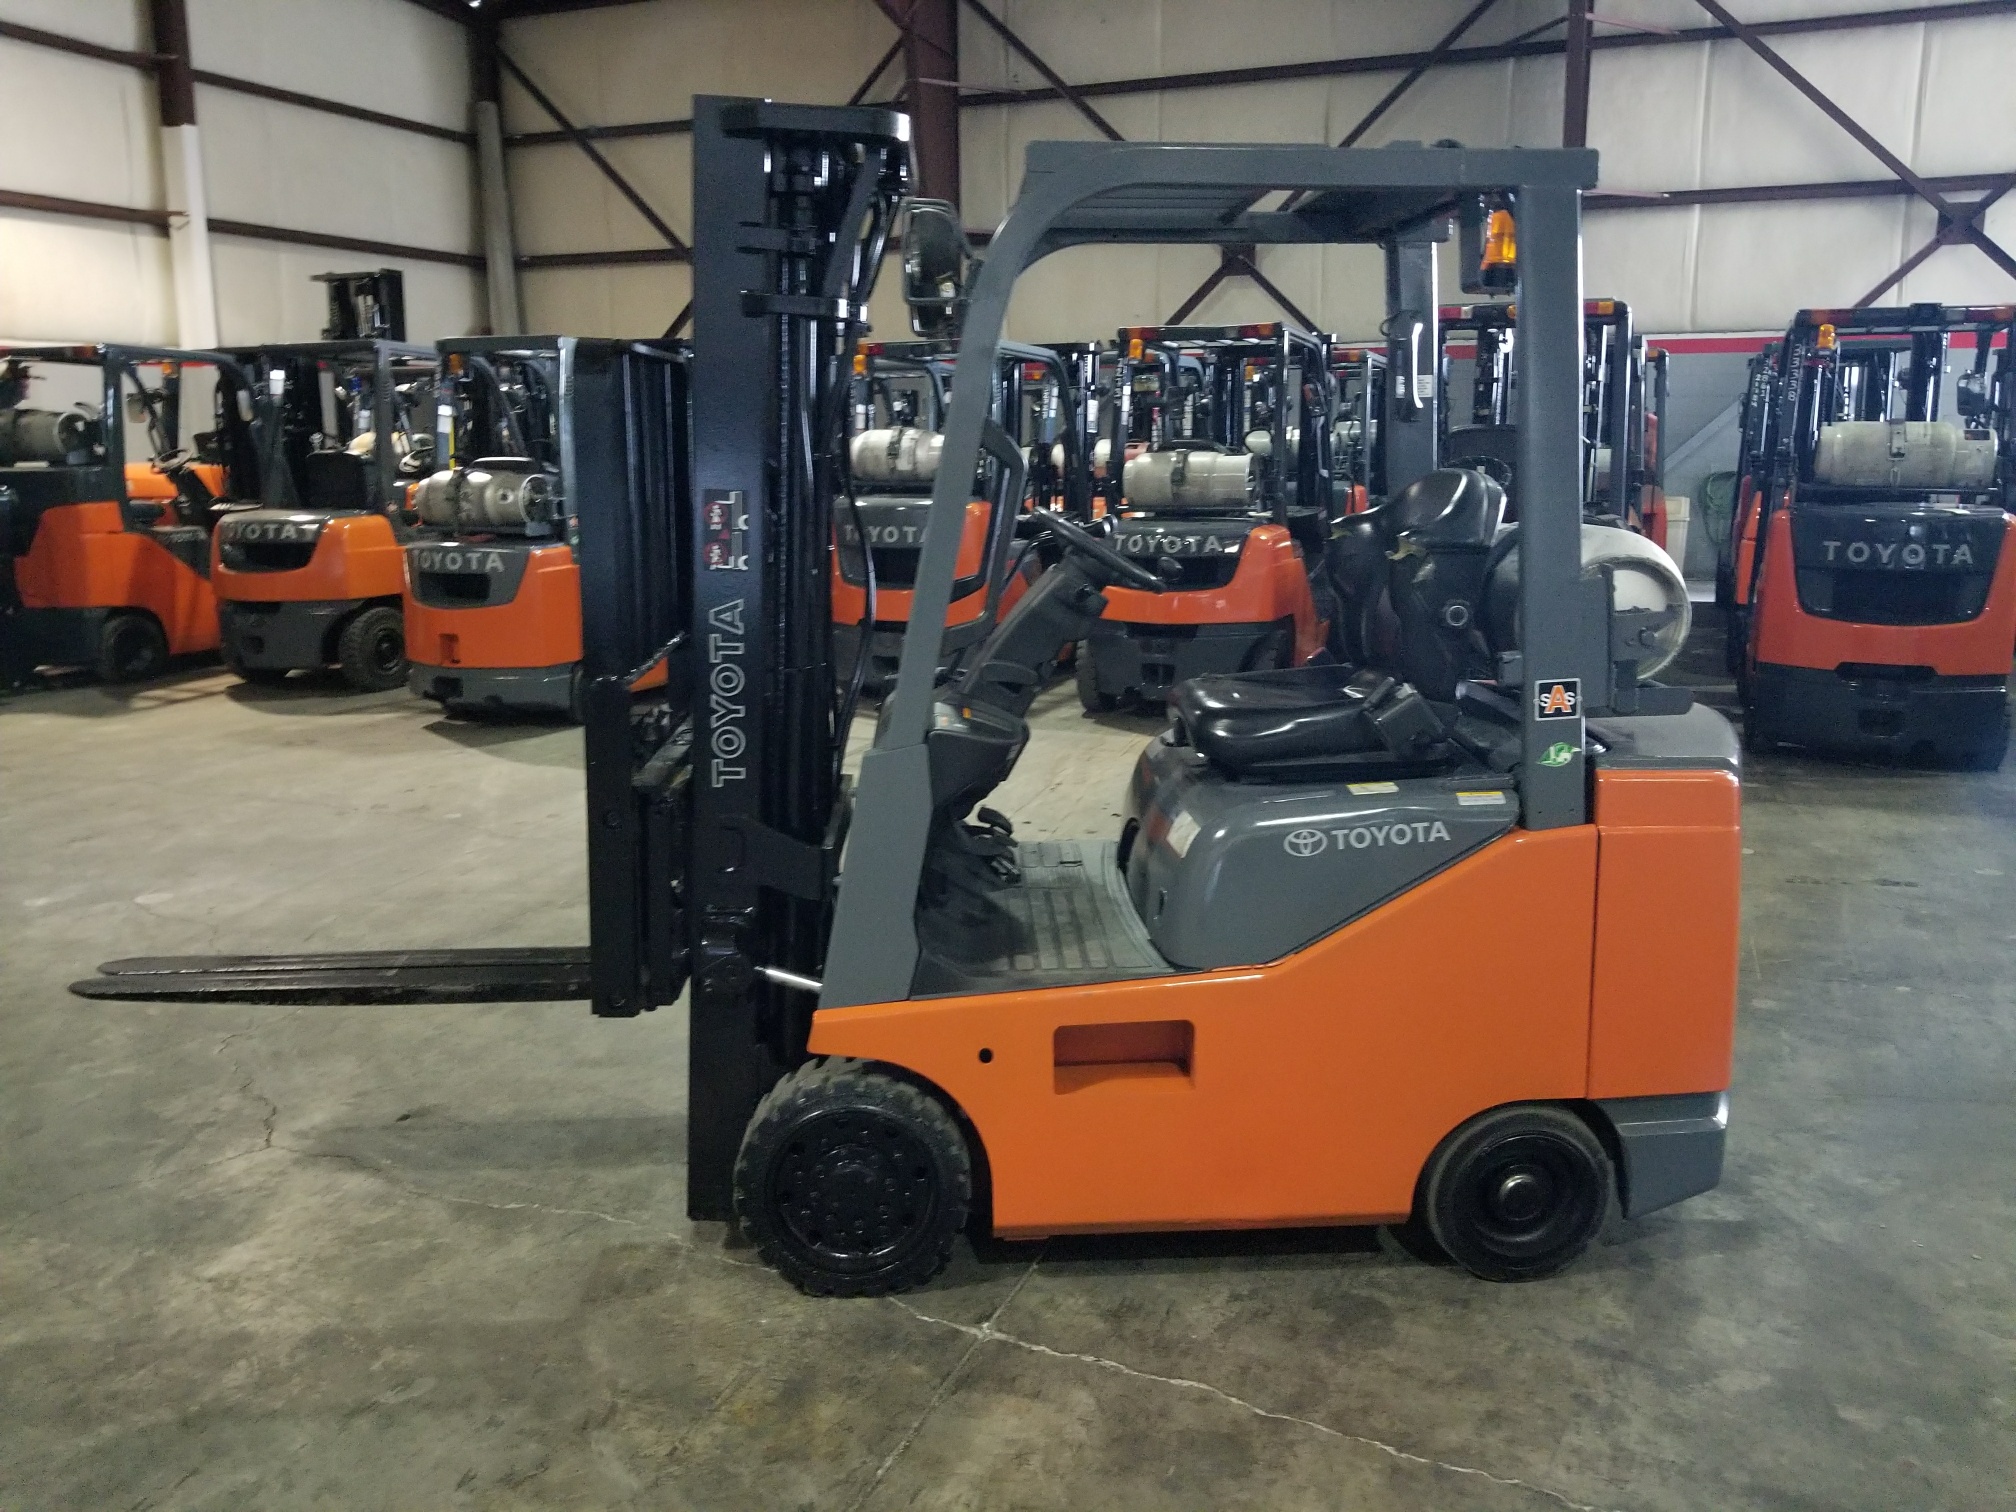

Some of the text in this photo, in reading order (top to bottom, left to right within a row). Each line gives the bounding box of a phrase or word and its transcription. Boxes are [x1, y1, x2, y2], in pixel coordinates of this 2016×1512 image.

[1113, 533, 1223, 554] TOYOTA
[1822, 540, 1974, 566] TOYOTA
[411, 549, 505, 573] TOYOTA
[708, 598, 747, 788] TOYOTA
[1330, 821, 1452, 850] TOYOTA
